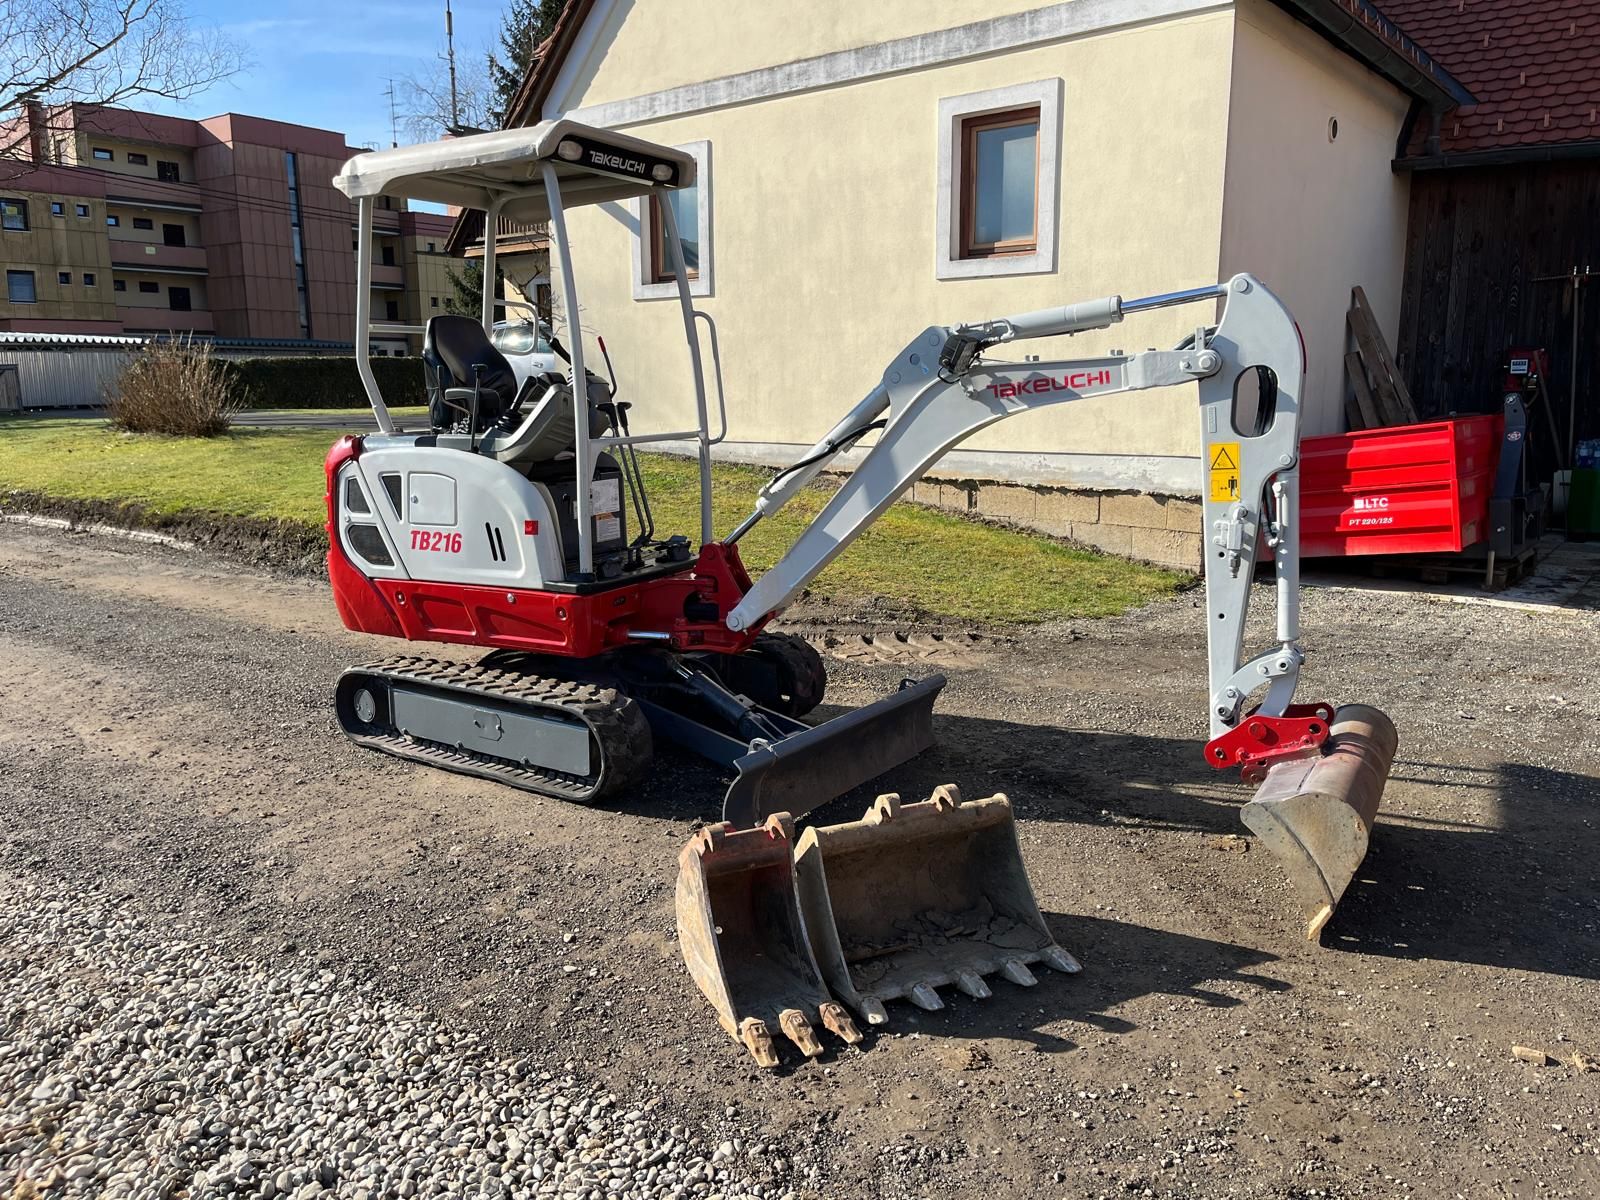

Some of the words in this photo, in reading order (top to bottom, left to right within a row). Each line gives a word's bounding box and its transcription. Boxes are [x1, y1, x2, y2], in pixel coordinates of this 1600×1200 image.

[589, 150, 646, 174] TAKEUCHI
[986, 370, 1111, 399] TAKEUCHI
[1365, 497, 1389, 508] LTC
[1349, 518, 1361, 526] PT
[1362, 517, 1393, 525] 220/125
[410, 530, 463, 554] TB216
